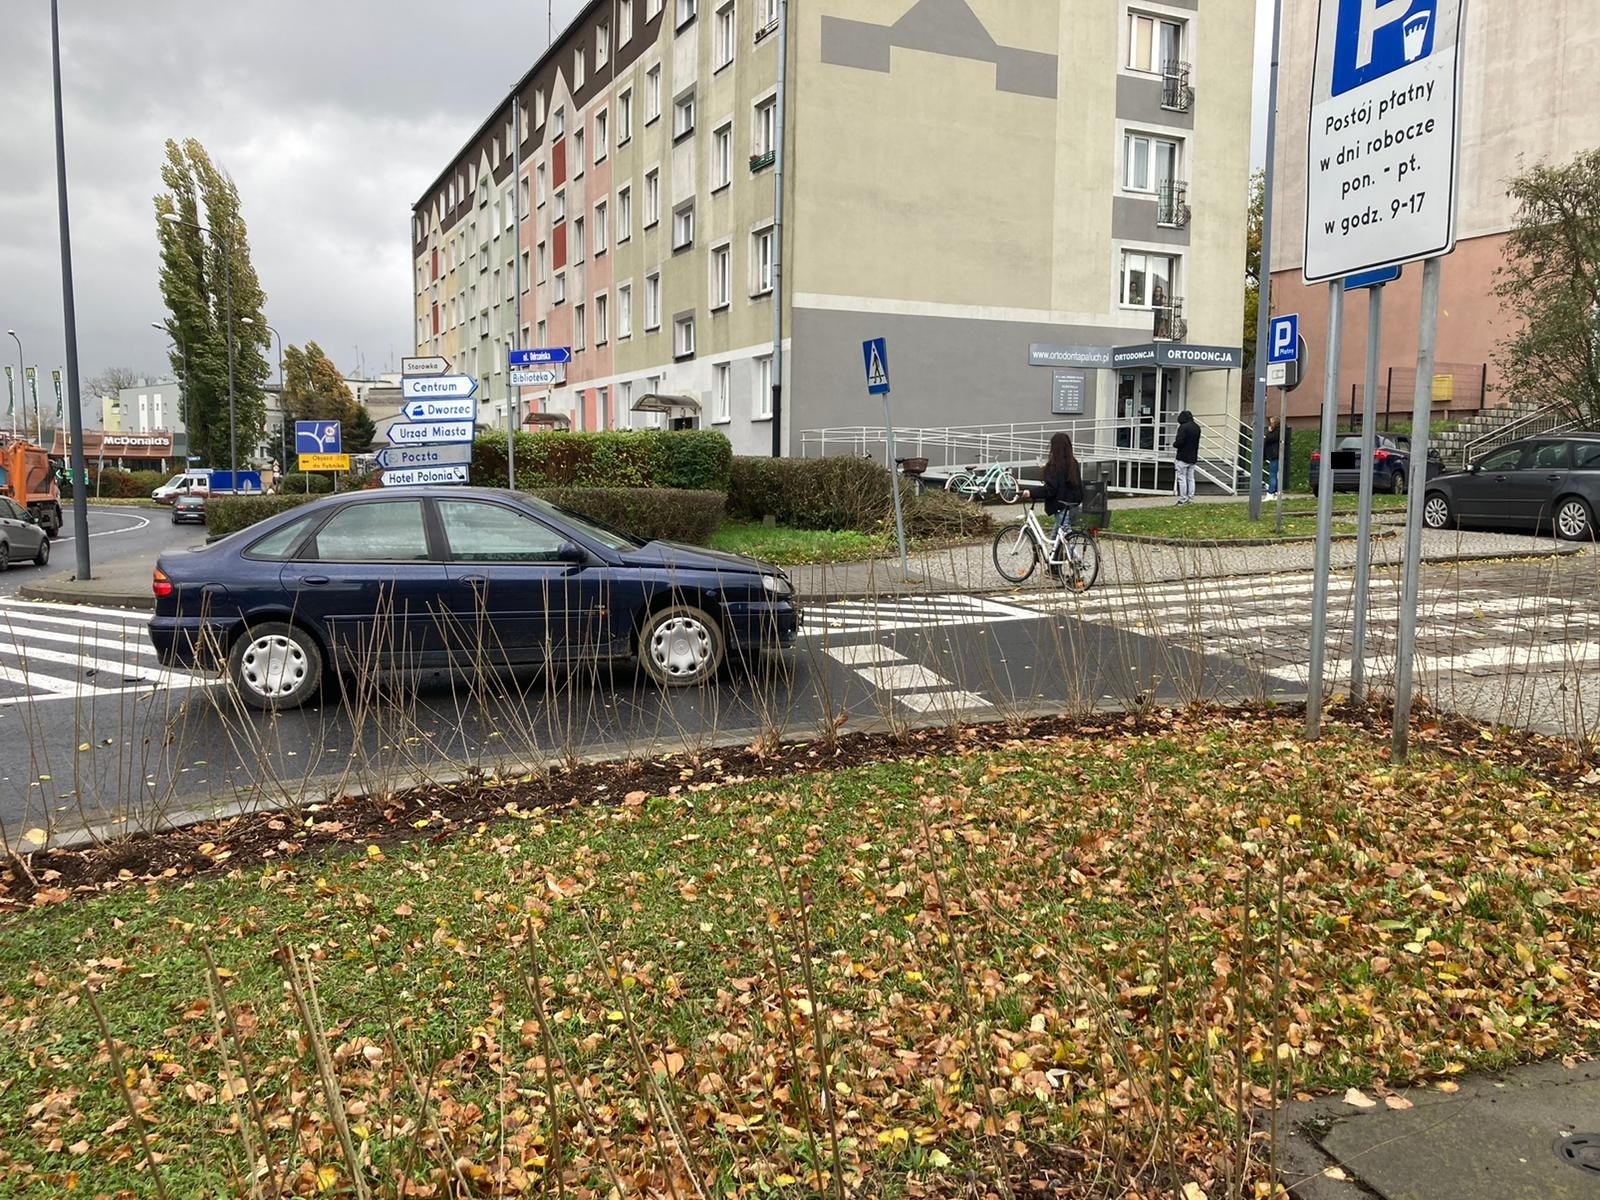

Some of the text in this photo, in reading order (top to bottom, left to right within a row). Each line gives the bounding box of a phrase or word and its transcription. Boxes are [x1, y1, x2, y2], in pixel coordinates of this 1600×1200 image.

[1325, 80, 1435, 135] Postój płatny
[1320, 118, 1435, 172] w dni robocze
[1341, 174, 1375, 200] pon.
[1398, 154, 1421, 182] pt.
[1324, 192, 1426, 236] w godz. 9-17
[1274, 321, 1292, 357] P
[1032, 350, 1110, 364] www.ortodontapaluch.pl
[1114, 350, 1155, 362] ORTODONCJA
[1167, 349, 1233, 362] ORTODONCJA
[512, 373, 549, 383] Biblioteka
[413, 382, 457, 393] Centrum
[427, 404, 471, 415] Dworzec
[103, 436, 170, 446] McDonald's
[400, 427, 467, 442] Urząd Miasta
[401, 452, 438, 463] Poczta
[388, 469, 453, 483] Hotel Polonia
